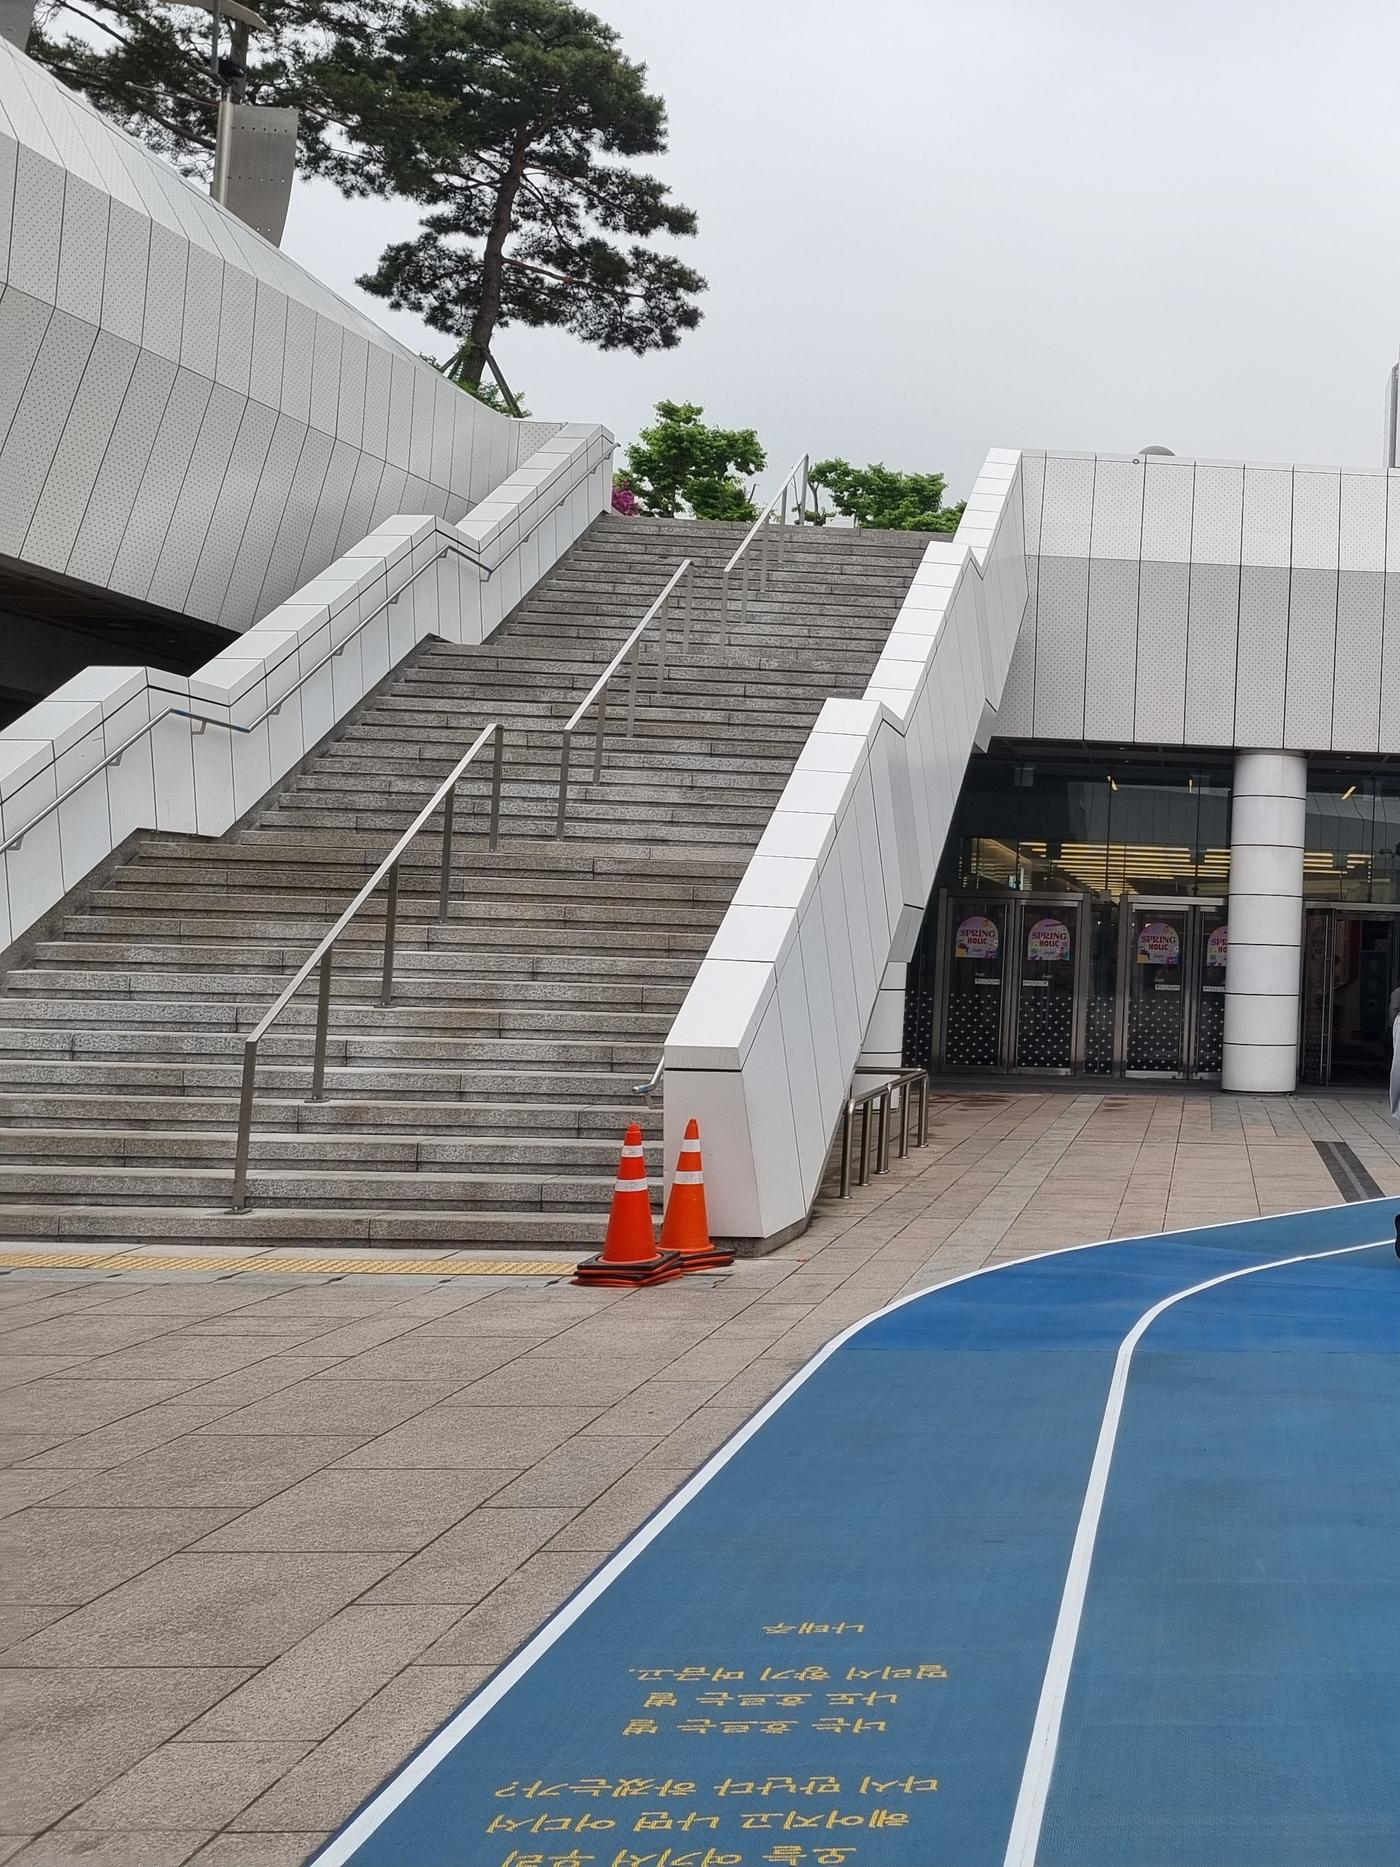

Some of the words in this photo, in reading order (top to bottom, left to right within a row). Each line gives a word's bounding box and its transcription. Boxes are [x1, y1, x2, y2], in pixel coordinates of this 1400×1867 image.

[960, 928, 996, 938] SPRING
[967, 937, 988, 945] HOLIC
[1031, 931, 1067, 941] SPRING
[1141, 935, 1177, 944] SPRING
[1039, 940, 1059, 948] HOLIC
[1148, 943, 1169, 951] HOLIC
[1210, 938, 1228, 946] SPR
[763, 1621, 866, 1636] 나태주
[760, 1665, 831, 1682] 향기
[846, 1664, 948, 1680] 멀리서
[643, 1691, 678, 1708] 별
[696, 1691, 812, 1707] 흐르는
[826, 1690, 898, 1707] 나도
[622, 1718, 658, 1735] 별
[676, 1717, 799, 1734] 흐르는
[812, 1716, 887, 1734] 너는
[495, 1777, 697, 1798] 하겠는가?
[714, 1775, 841, 1796] 만난다
[859, 1775, 939, 1794] 다시
[486, 1812, 616, 1834] 어디서
[633, 1811, 720, 1832] 나면
[740, 1809, 910, 1829] 헤어지고
[610, 1848, 743, 1867] 여기서
[762, 1845, 856, 1866] 오늘
